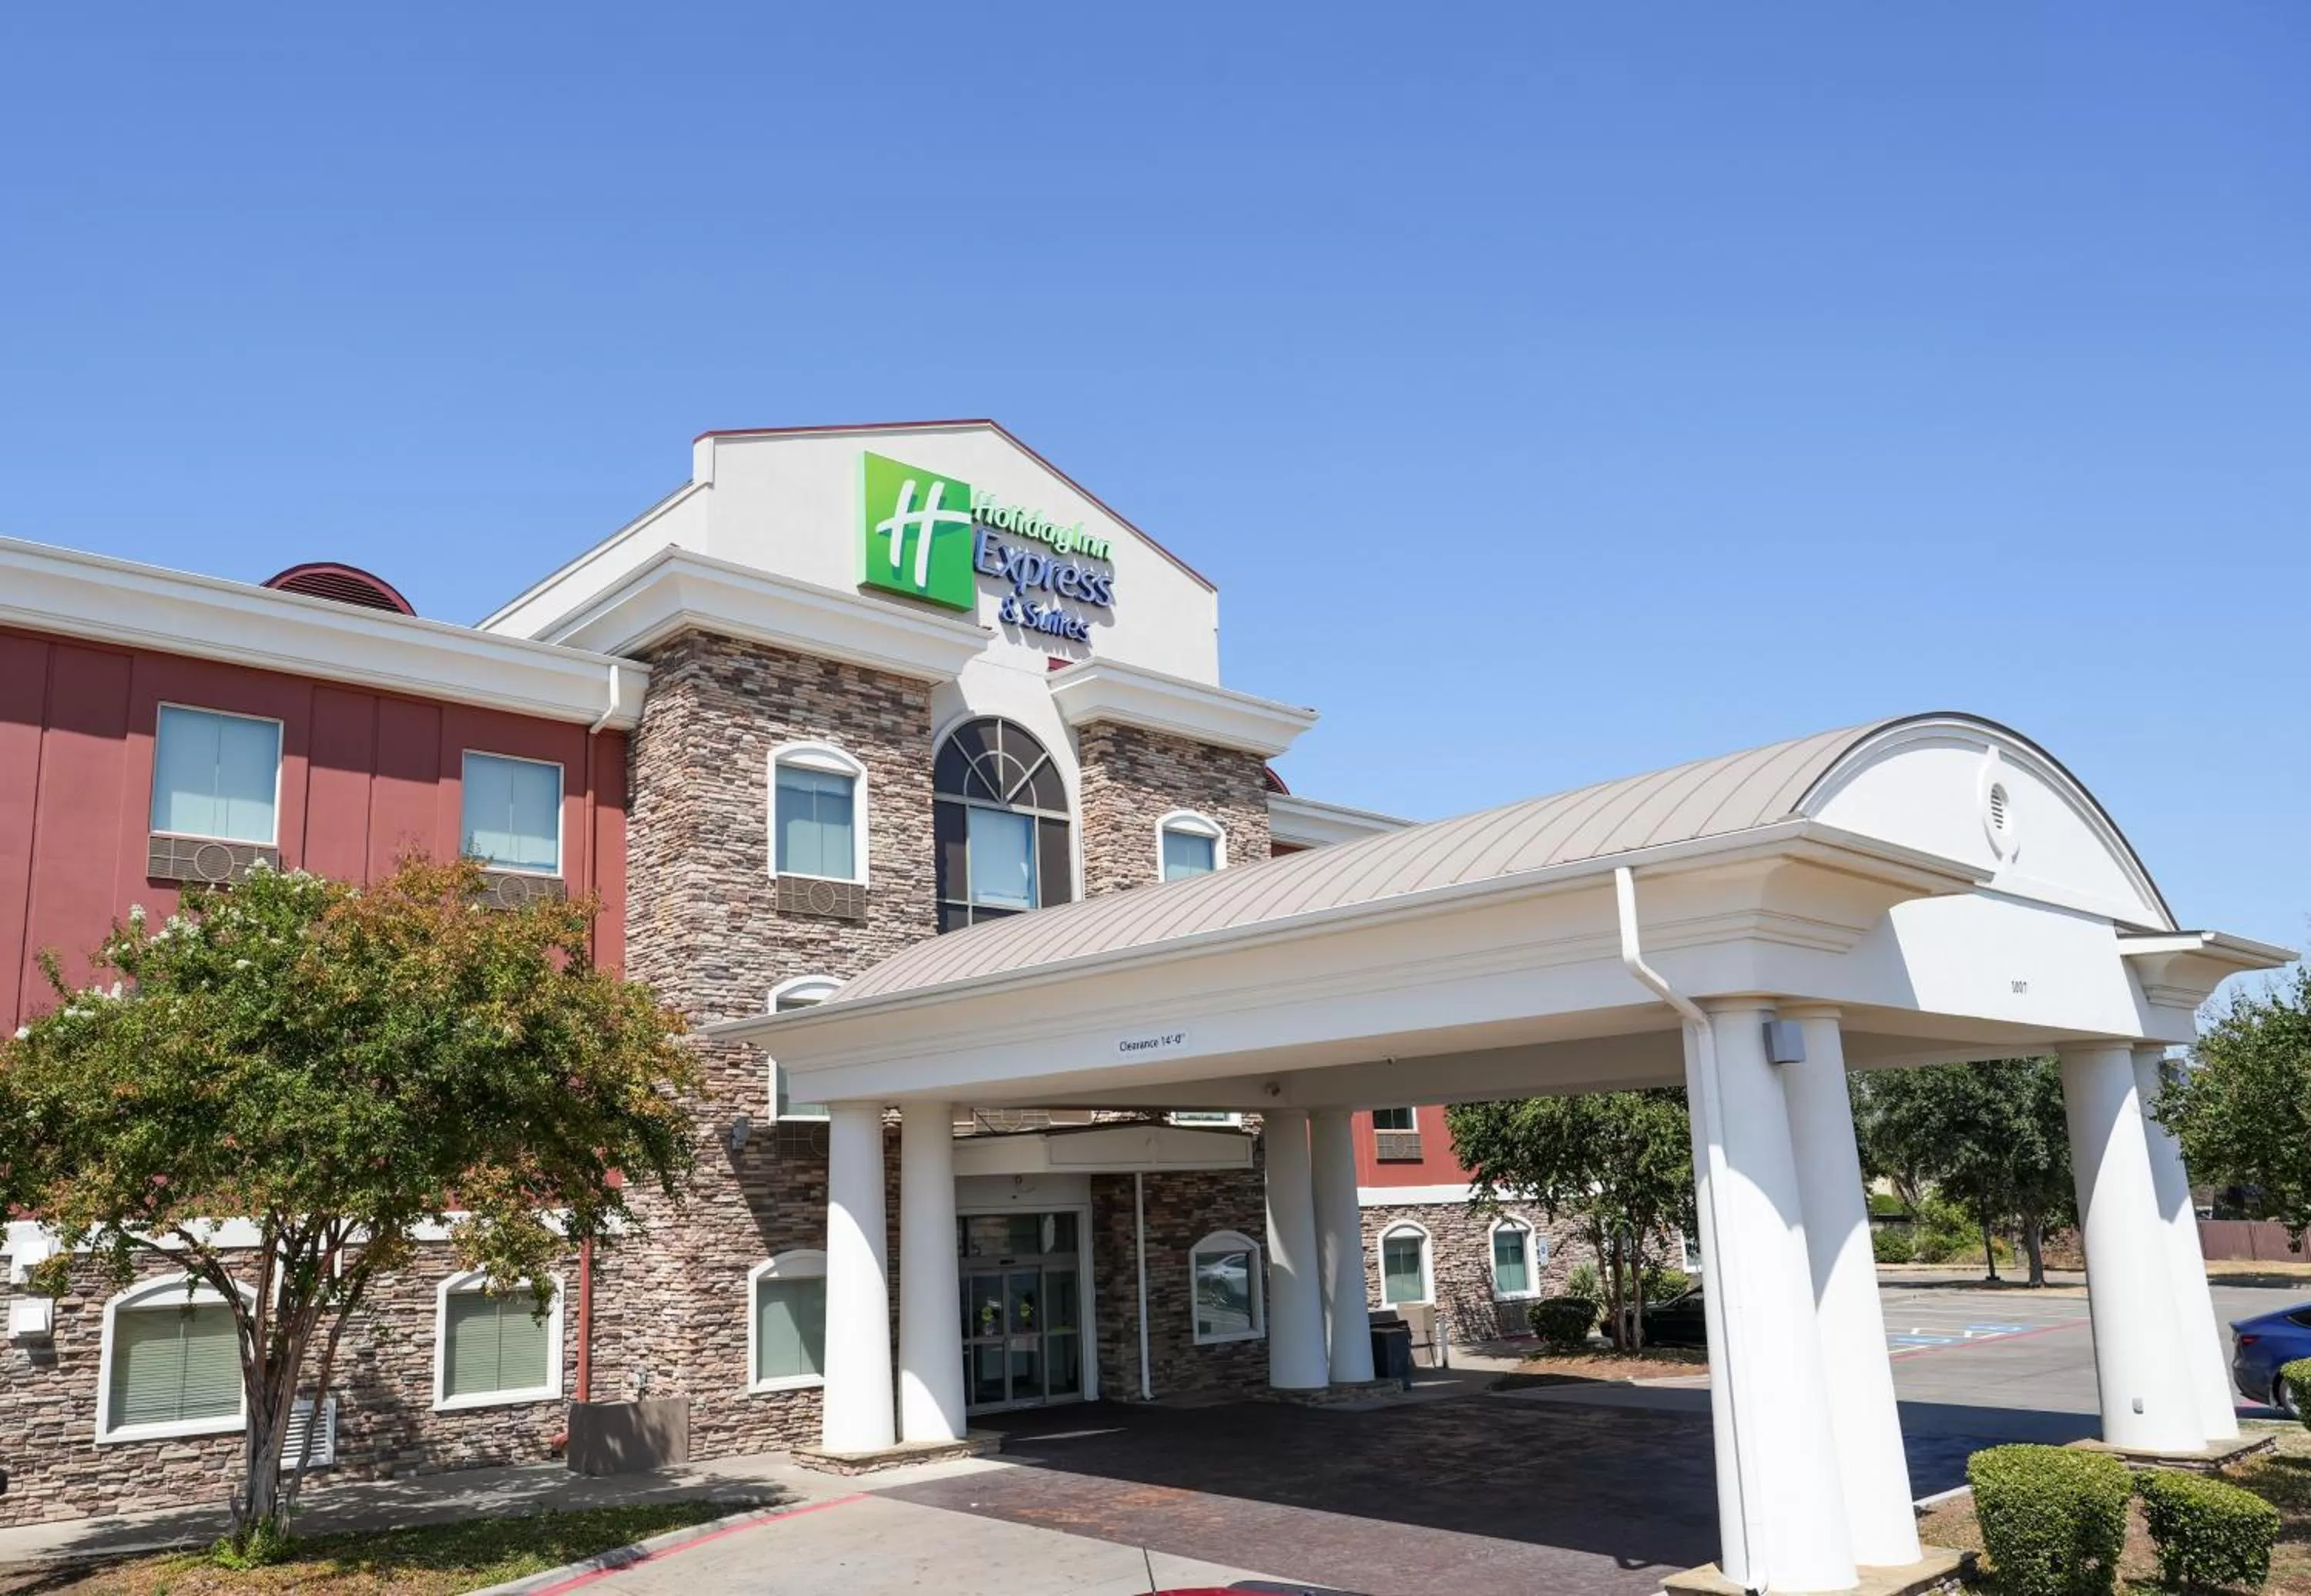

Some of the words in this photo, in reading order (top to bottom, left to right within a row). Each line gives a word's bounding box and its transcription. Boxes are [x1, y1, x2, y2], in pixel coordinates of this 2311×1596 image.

[972, 491, 1072, 555] Holiday
[1072, 522, 1112, 562] Inn
[974, 528, 1115, 607] Express
[998, 595, 1018, 624] &
[1021, 599, 1090, 642] Suites
[1119, 1039, 1159, 1052] Clearance
